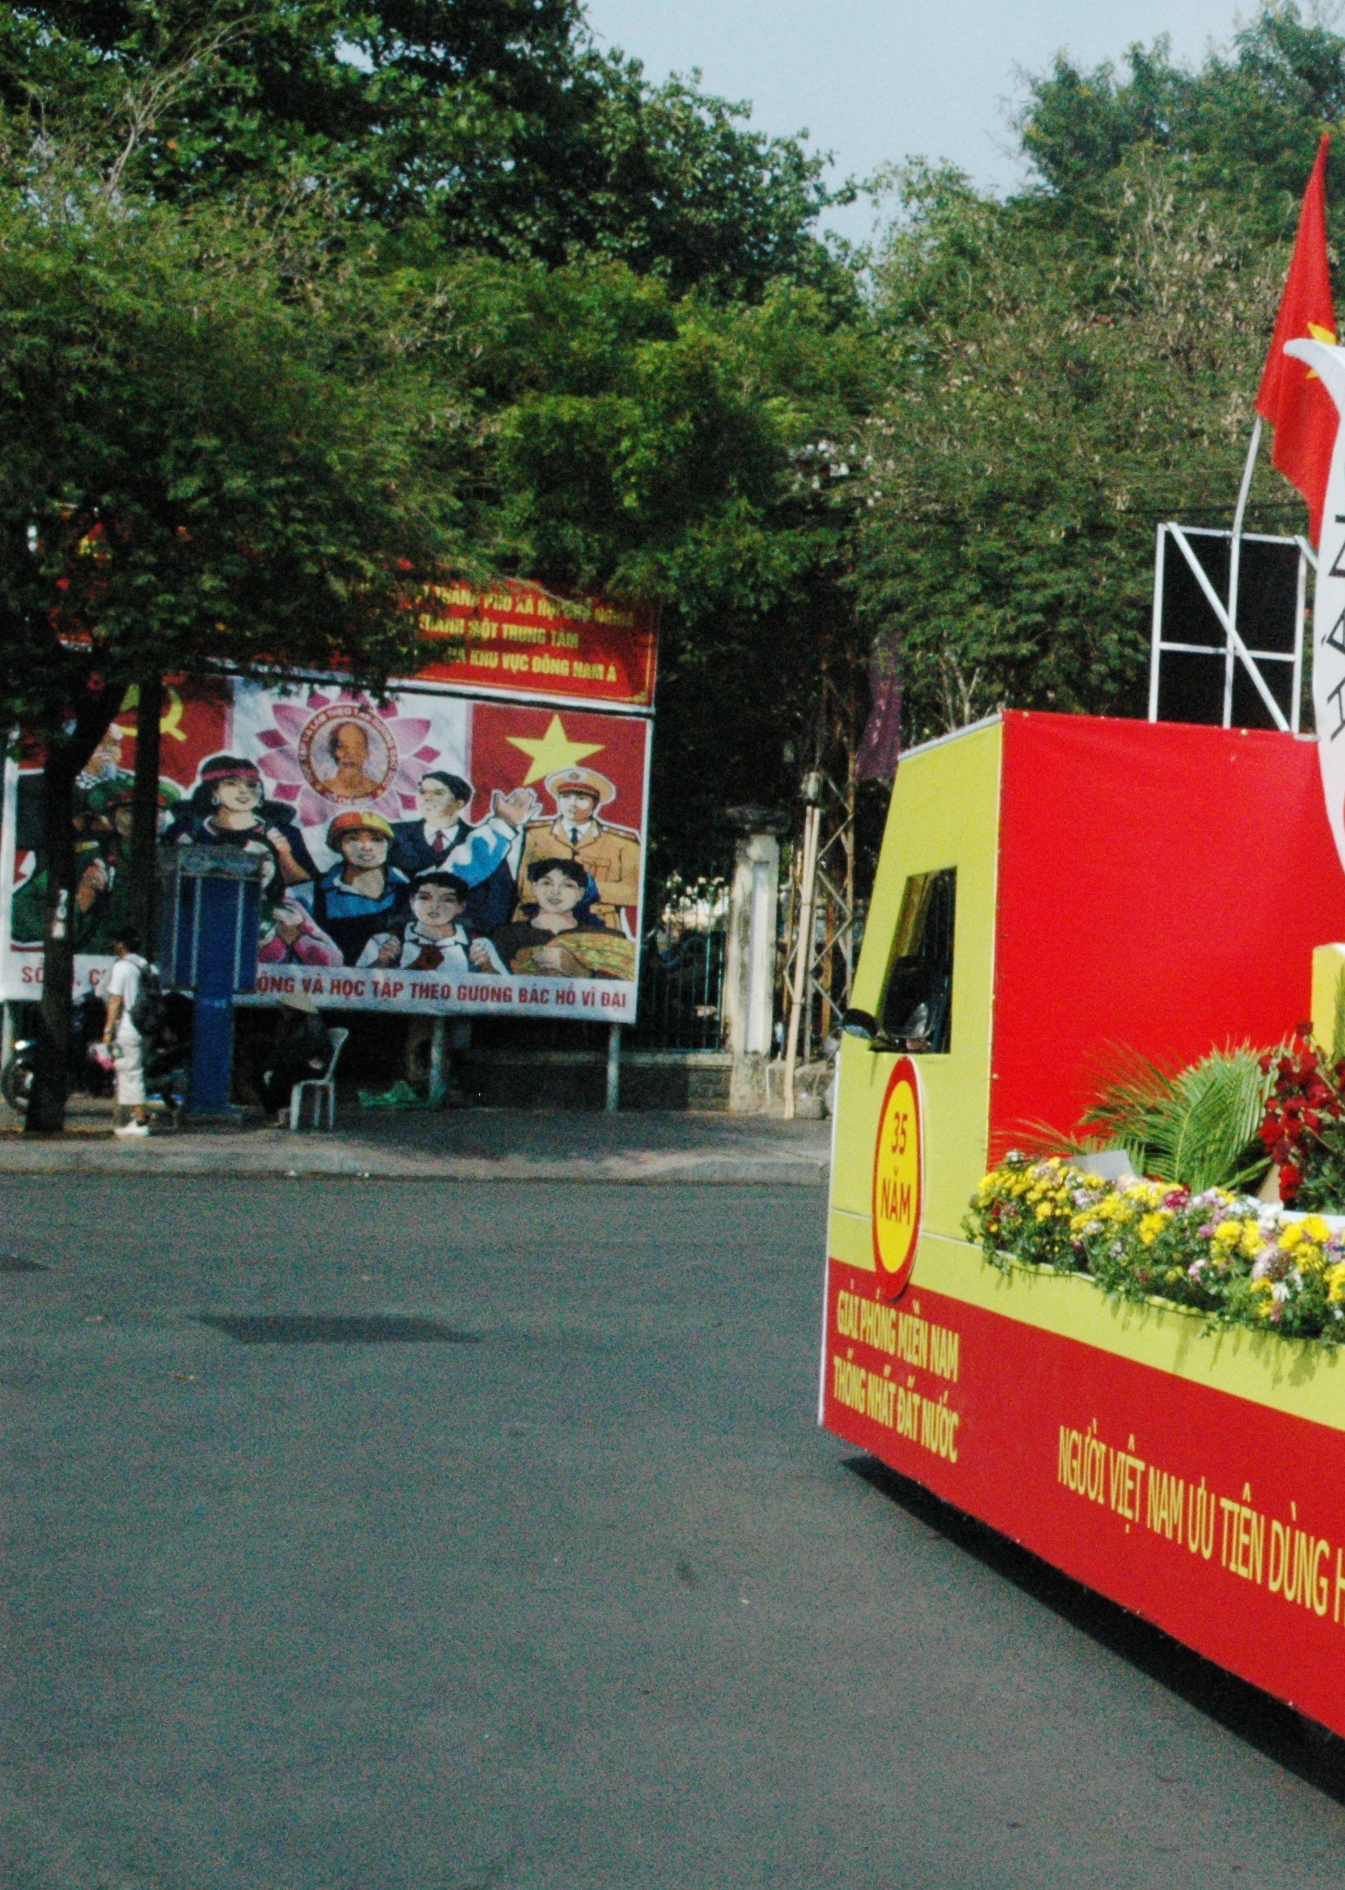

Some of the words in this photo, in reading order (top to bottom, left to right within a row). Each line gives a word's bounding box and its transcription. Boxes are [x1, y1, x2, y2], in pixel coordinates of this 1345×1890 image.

[572, 661, 605, 680] NAM
[330, 978, 366, 999] HỌC
[410, 982, 451, 1000] THEO
[518, 982, 550, 1004] BÁC
[891, 1112, 907, 1155] 35
[880, 1168, 911, 1227] NĂM
[837, 1278, 860, 1340] GIẢI
[860, 1287, 897, 1357] PHÓNG
[897, 1299, 929, 1369] MIỀN
[930, 1324, 960, 1384] NAM
[834, 1347, 867, 1414] THỐNG
[867, 1363, 897, 1430] NHẤT
[921, 1390, 960, 1464] NƯỚC
[1058, 1417, 1107, 1505] NGƯỜI
[1109, 1433, 1146, 1534] VIỆT
[1146, 1466, 1184, 1545] NAM
[1187, 1476, 1216, 1560] ƯU
[1219, 1481, 1265, 1586] TIÊN
[1268, 1501, 1331, 1617] DÙNG
